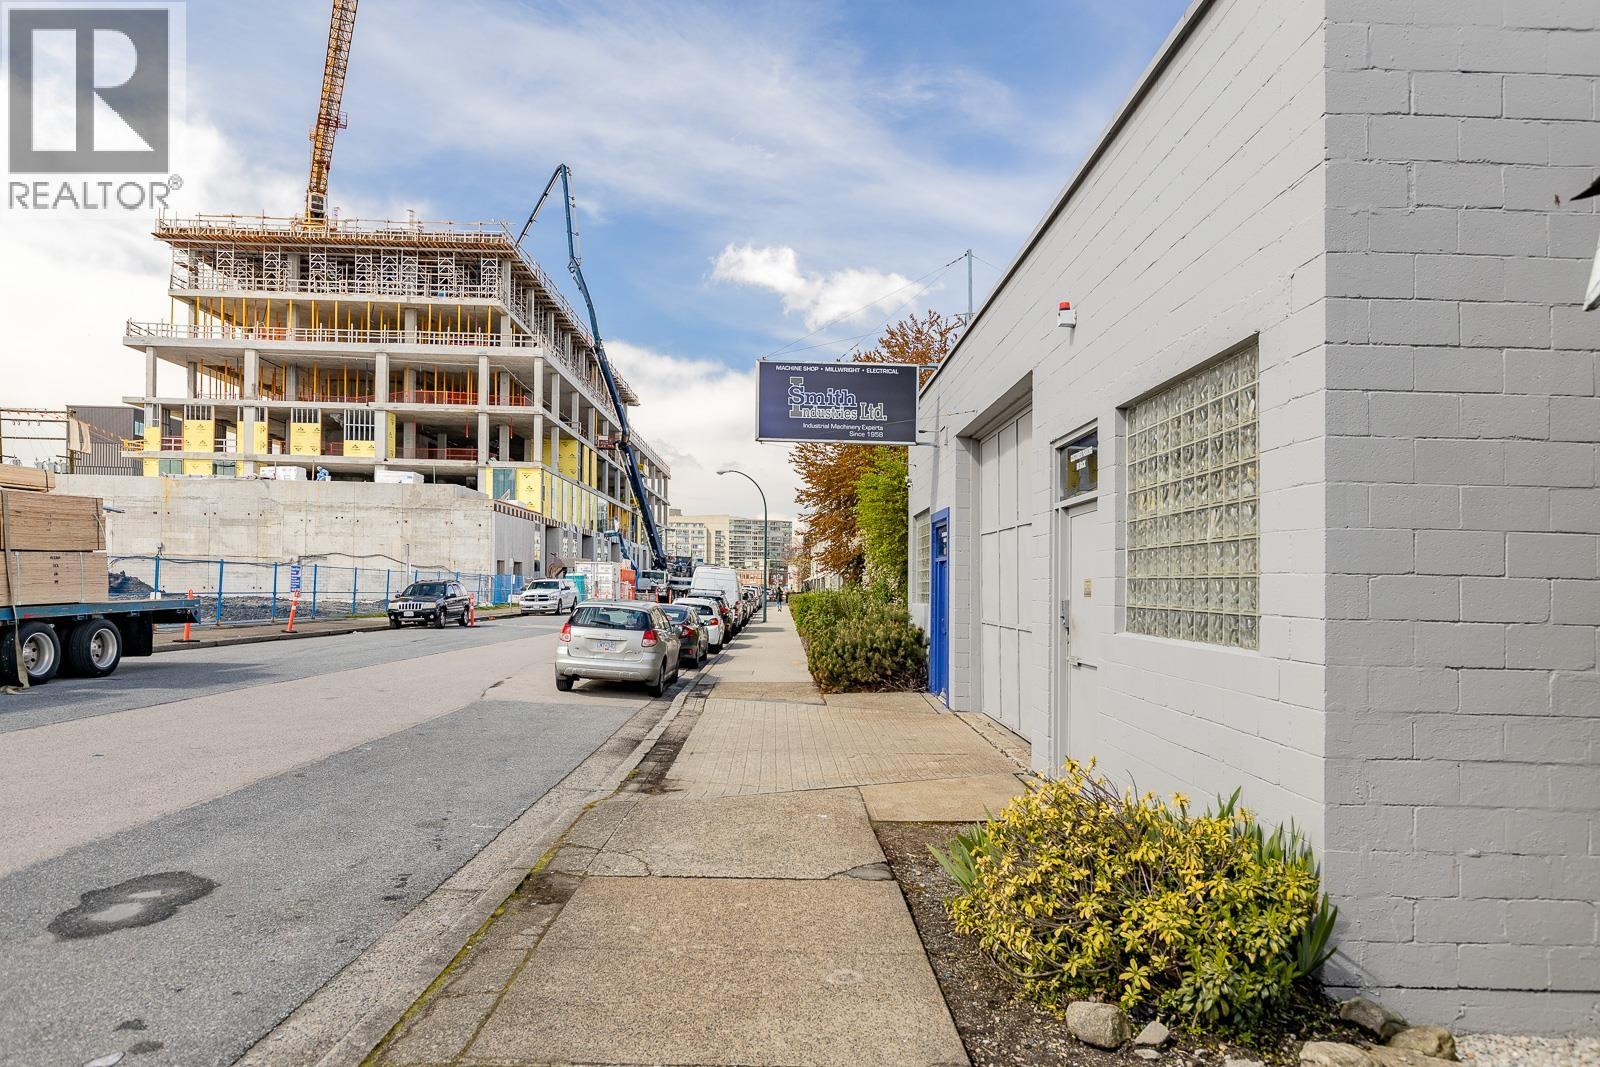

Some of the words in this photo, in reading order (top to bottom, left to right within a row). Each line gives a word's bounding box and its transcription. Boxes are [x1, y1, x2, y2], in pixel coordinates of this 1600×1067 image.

[788, 385, 858, 407] Smith
[859, 402, 888, 421] Ltd.
[831, 423, 861, 431] Machinery
